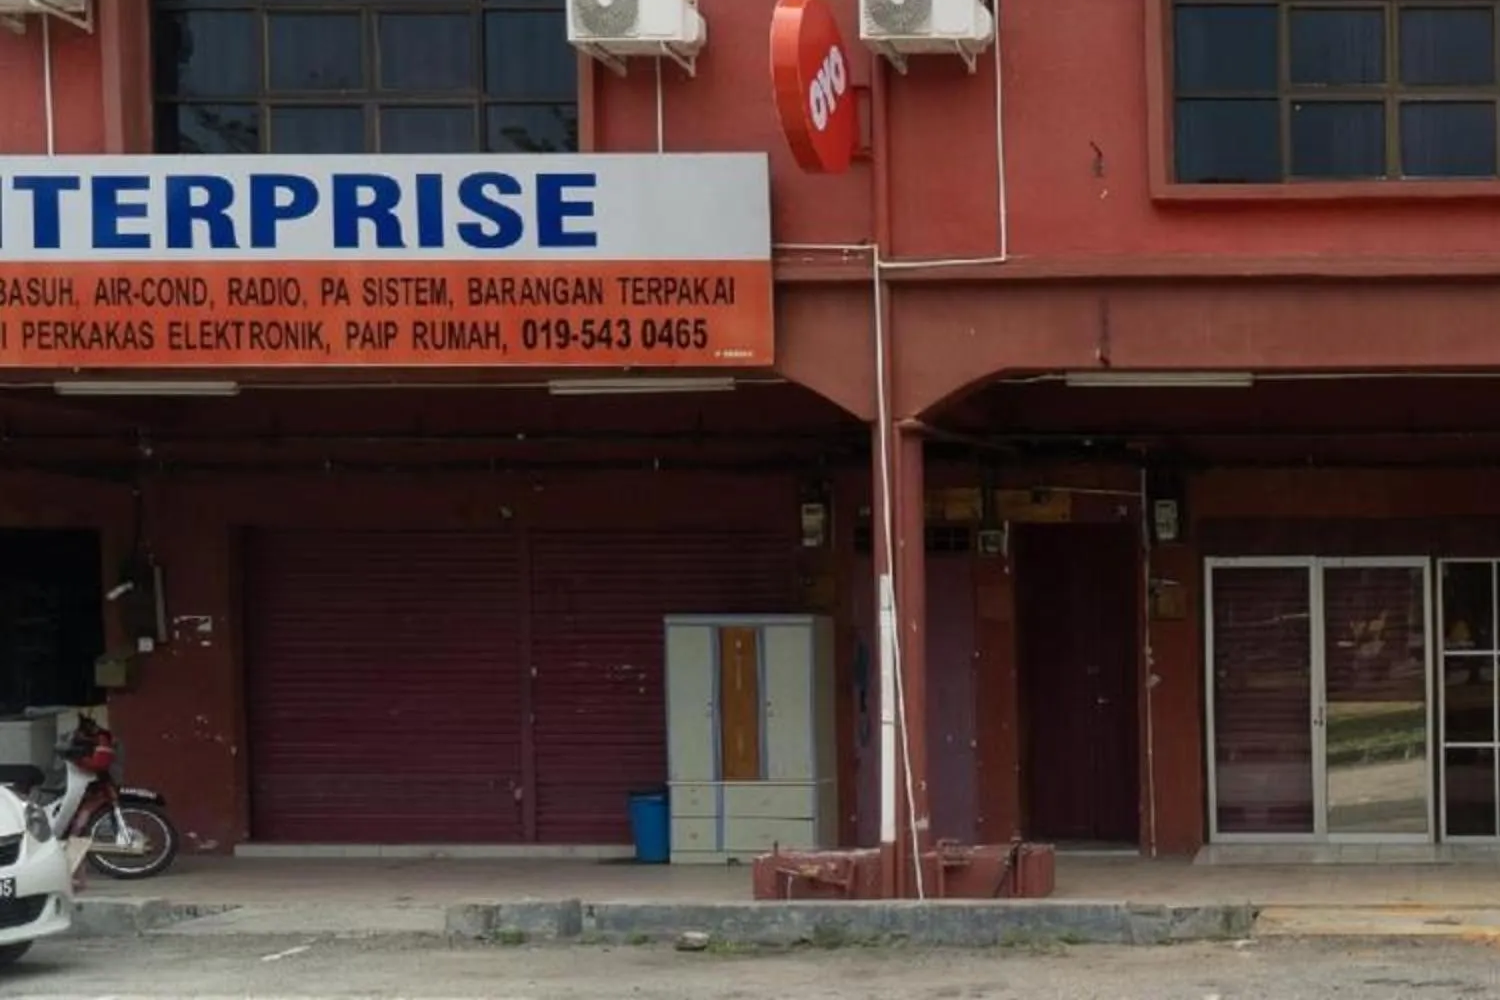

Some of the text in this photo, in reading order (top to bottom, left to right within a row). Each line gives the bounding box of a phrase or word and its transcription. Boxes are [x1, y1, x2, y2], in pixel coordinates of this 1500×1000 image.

[810, 45, 845, 132] OYO
[0, 172, 597, 249] TERPRISE
[95, 277, 214, 309] AIR-COND,
[321, 277, 349, 306] PA
[363, 277, 453, 309] SISTEM,
[468, 277, 603, 306] BARANGAN
[617, 276, 735, 305] TERPAKAI
[22, 321, 154, 350] PERKAKAS
[168, 320, 331, 354] ELEKTRONIK,
[346, 321, 398, 349] PAIP
[412, 320, 507, 354] RUMAH,
[522, 318, 632, 350] 019-543
[640, 318, 708, 350] 0465
[0, 879, 13, 897] 5
